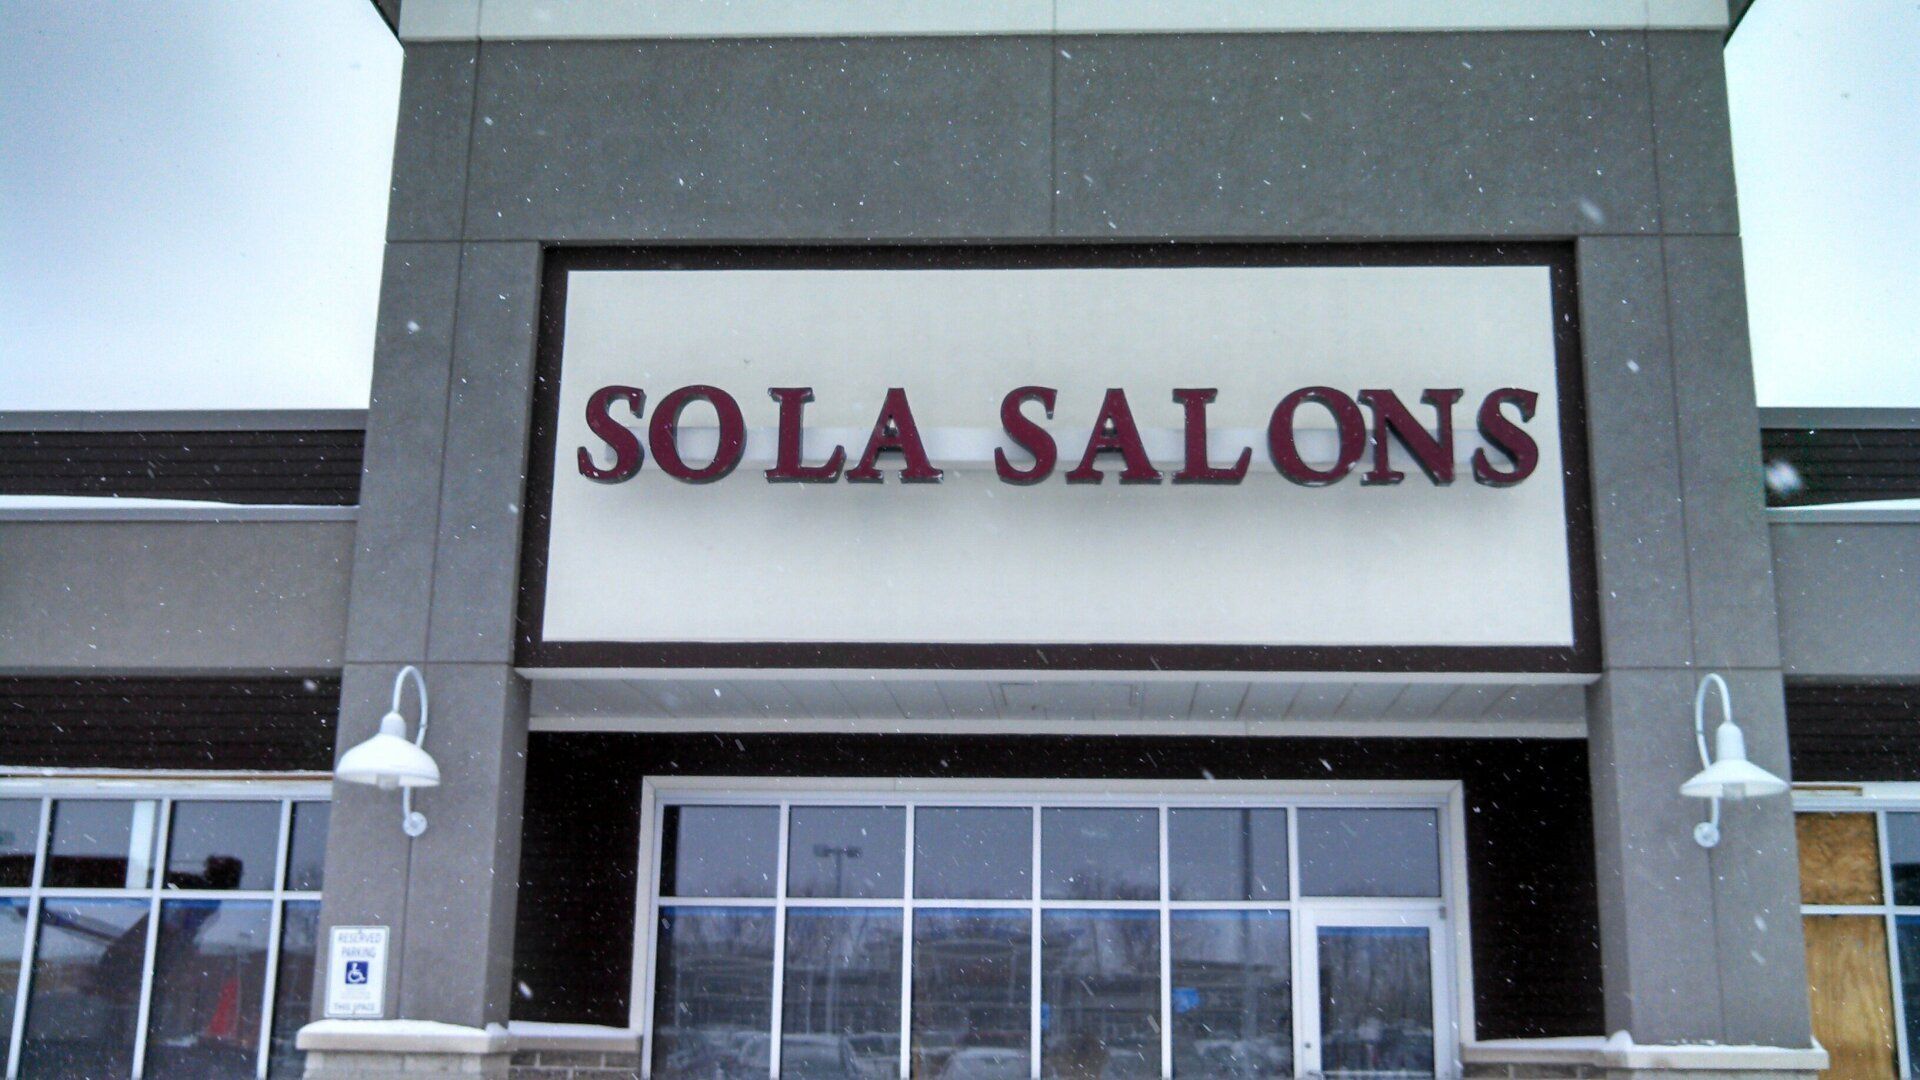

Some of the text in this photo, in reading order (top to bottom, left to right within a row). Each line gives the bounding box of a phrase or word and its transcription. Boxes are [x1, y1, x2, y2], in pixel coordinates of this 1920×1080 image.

[578, 386, 1539, 488] SOLA SALONS
[338, 933, 382, 944] RESERVED
[341, 946, 377, 958] PARKING
